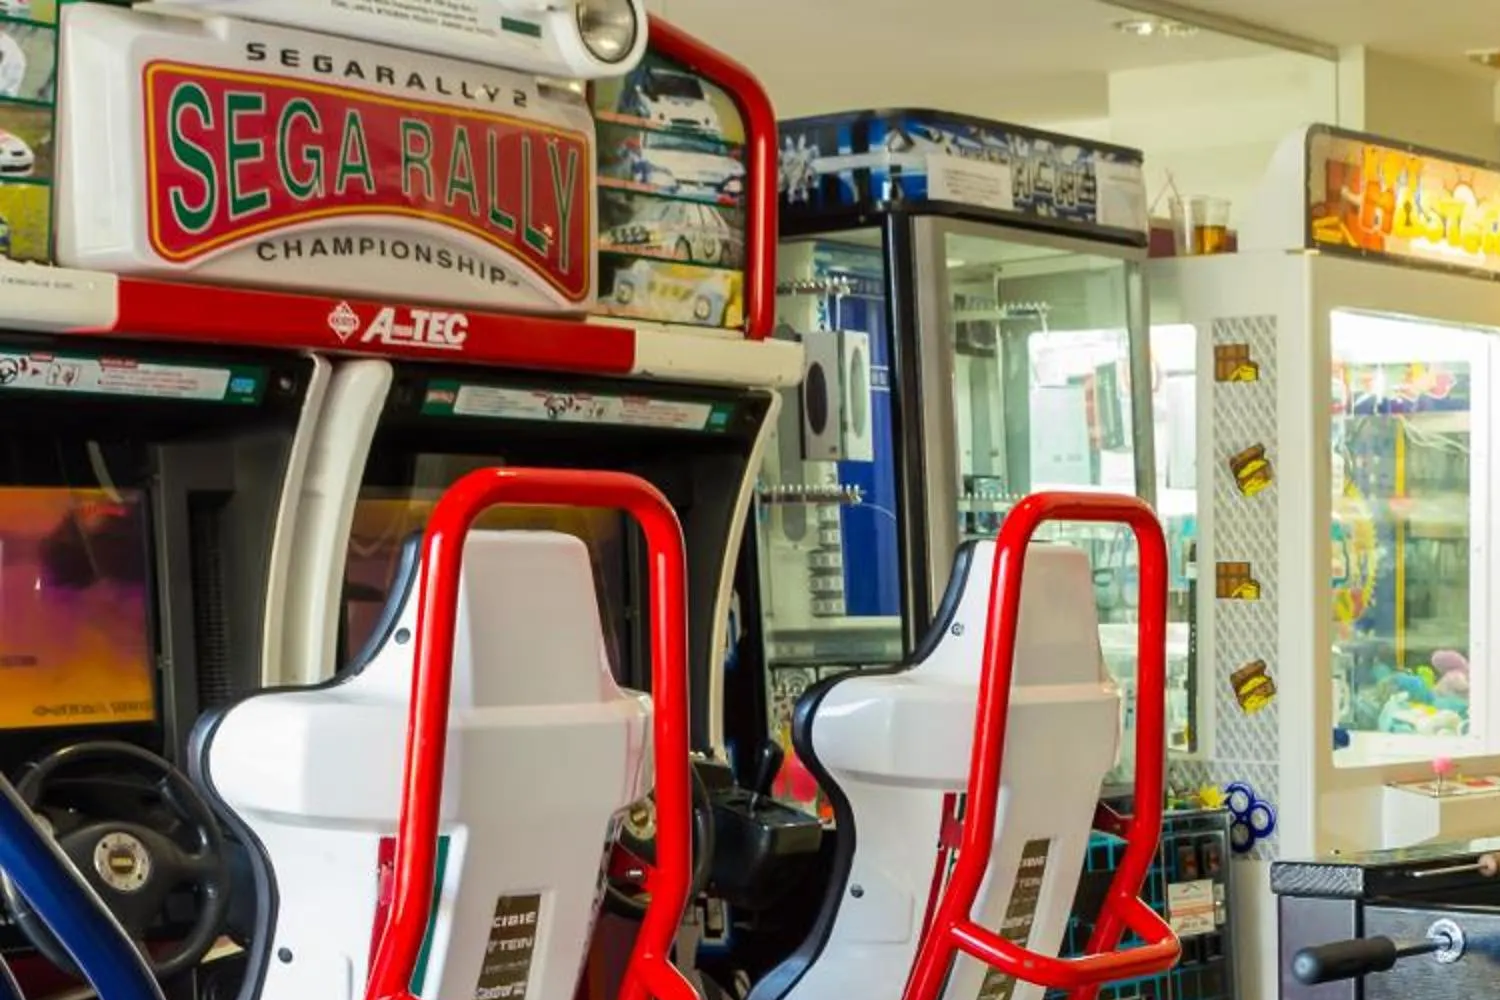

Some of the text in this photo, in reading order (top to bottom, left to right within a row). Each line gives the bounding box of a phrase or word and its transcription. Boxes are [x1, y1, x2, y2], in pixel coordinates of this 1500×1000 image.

[168, 81, 578, 275] SEGA RALLY
[256, 240, 506, 286] CHAMPIONSHIP
